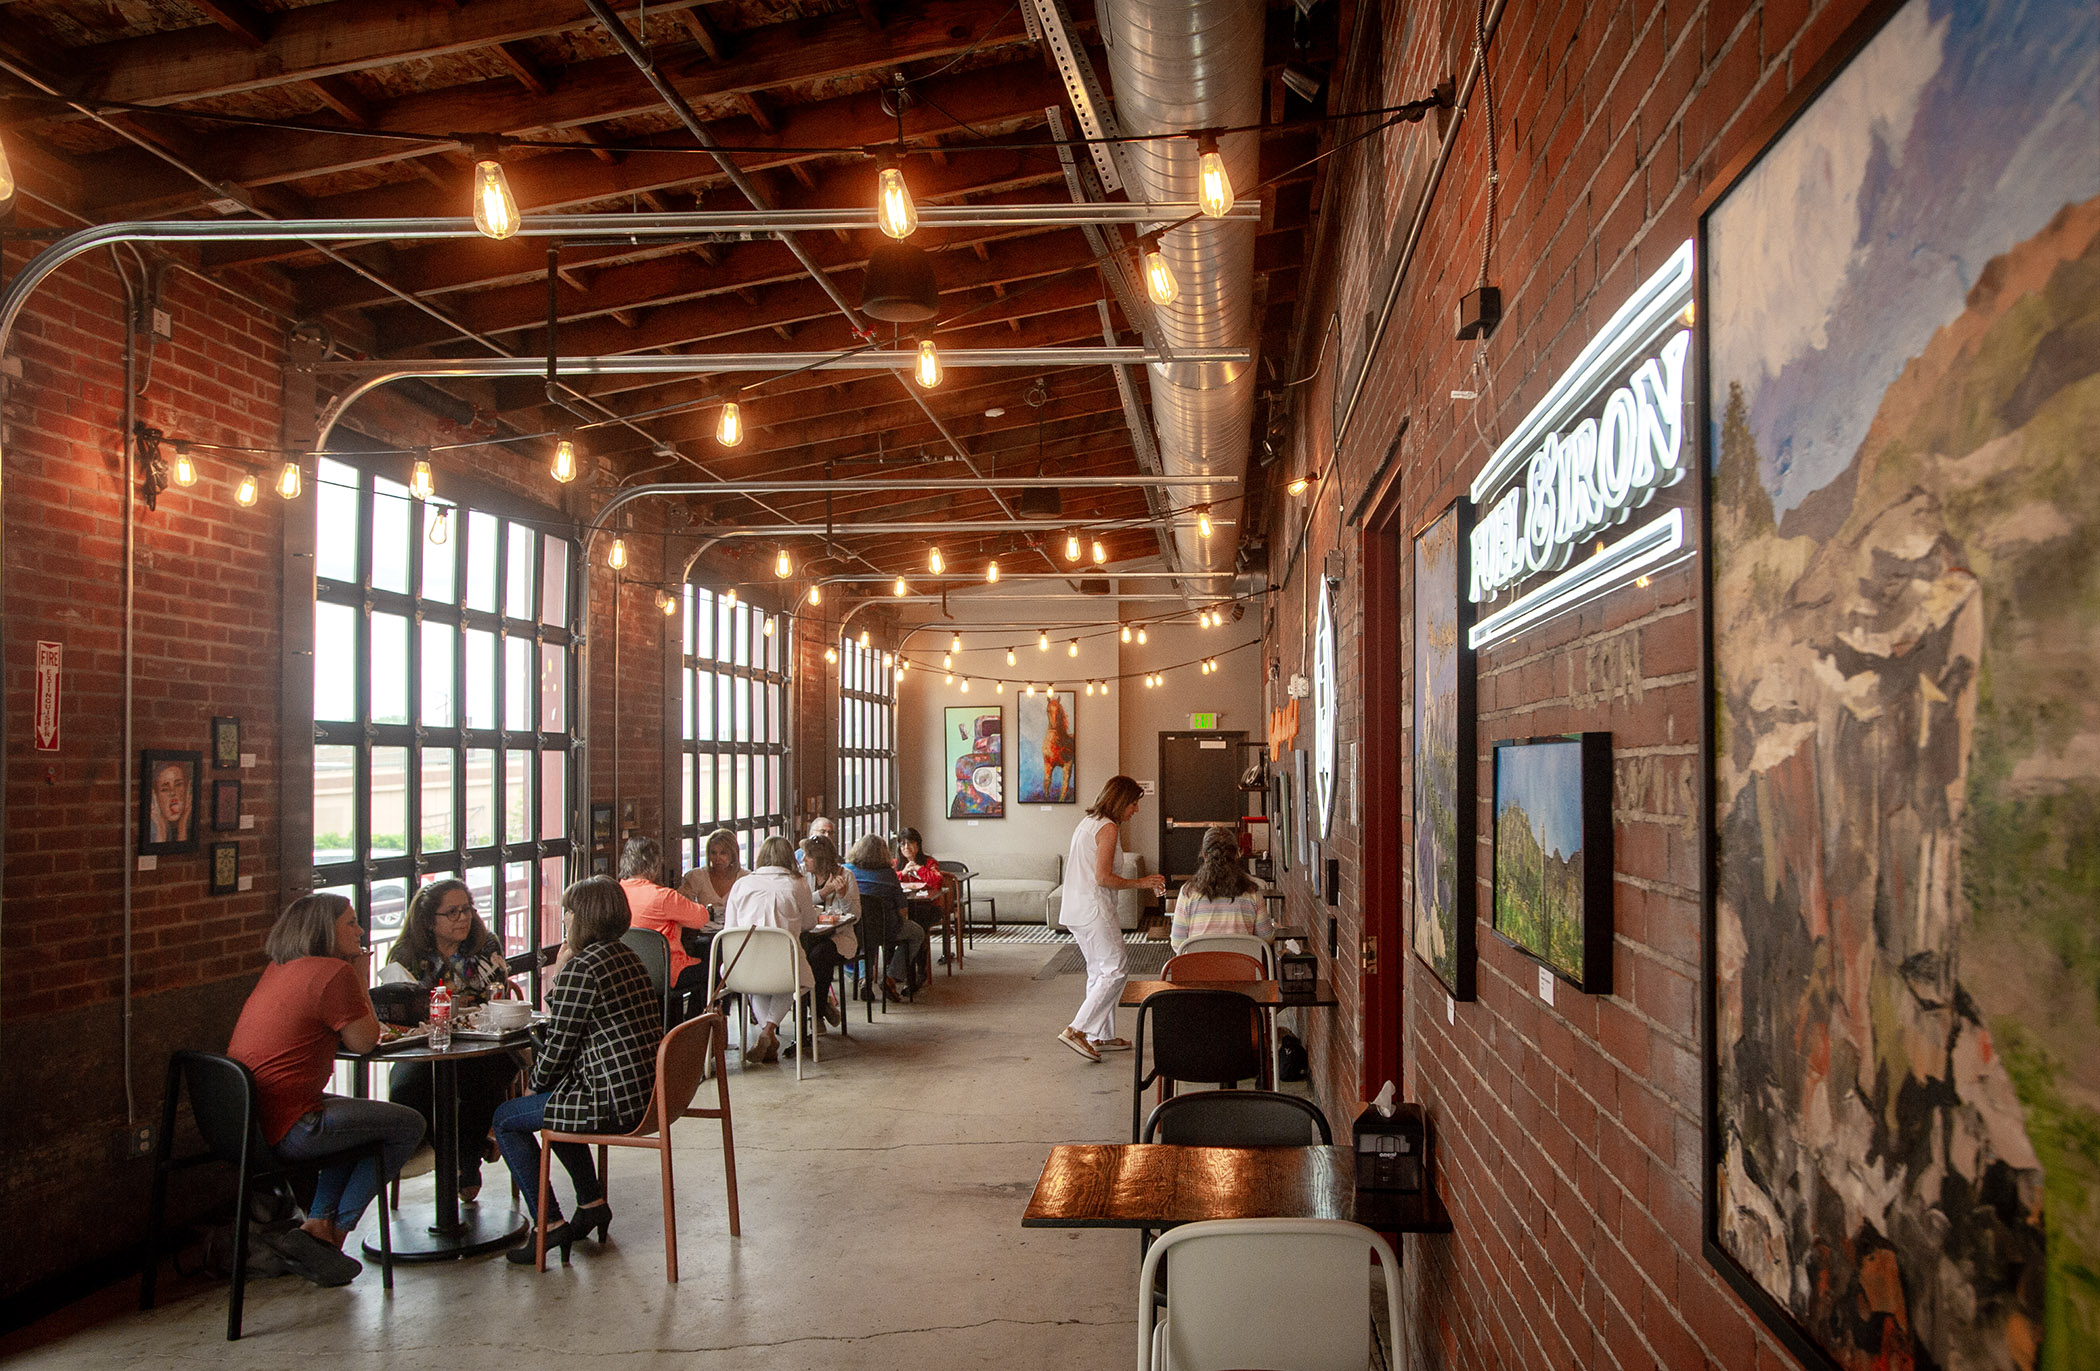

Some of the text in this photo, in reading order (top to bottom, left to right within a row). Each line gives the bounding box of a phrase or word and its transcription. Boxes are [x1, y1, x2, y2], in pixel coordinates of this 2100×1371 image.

[1556, 329, 1691, 544] IRON
[42, 651, 58, 666] FIRE
[1194, 713, 1213, 729] EXIT
